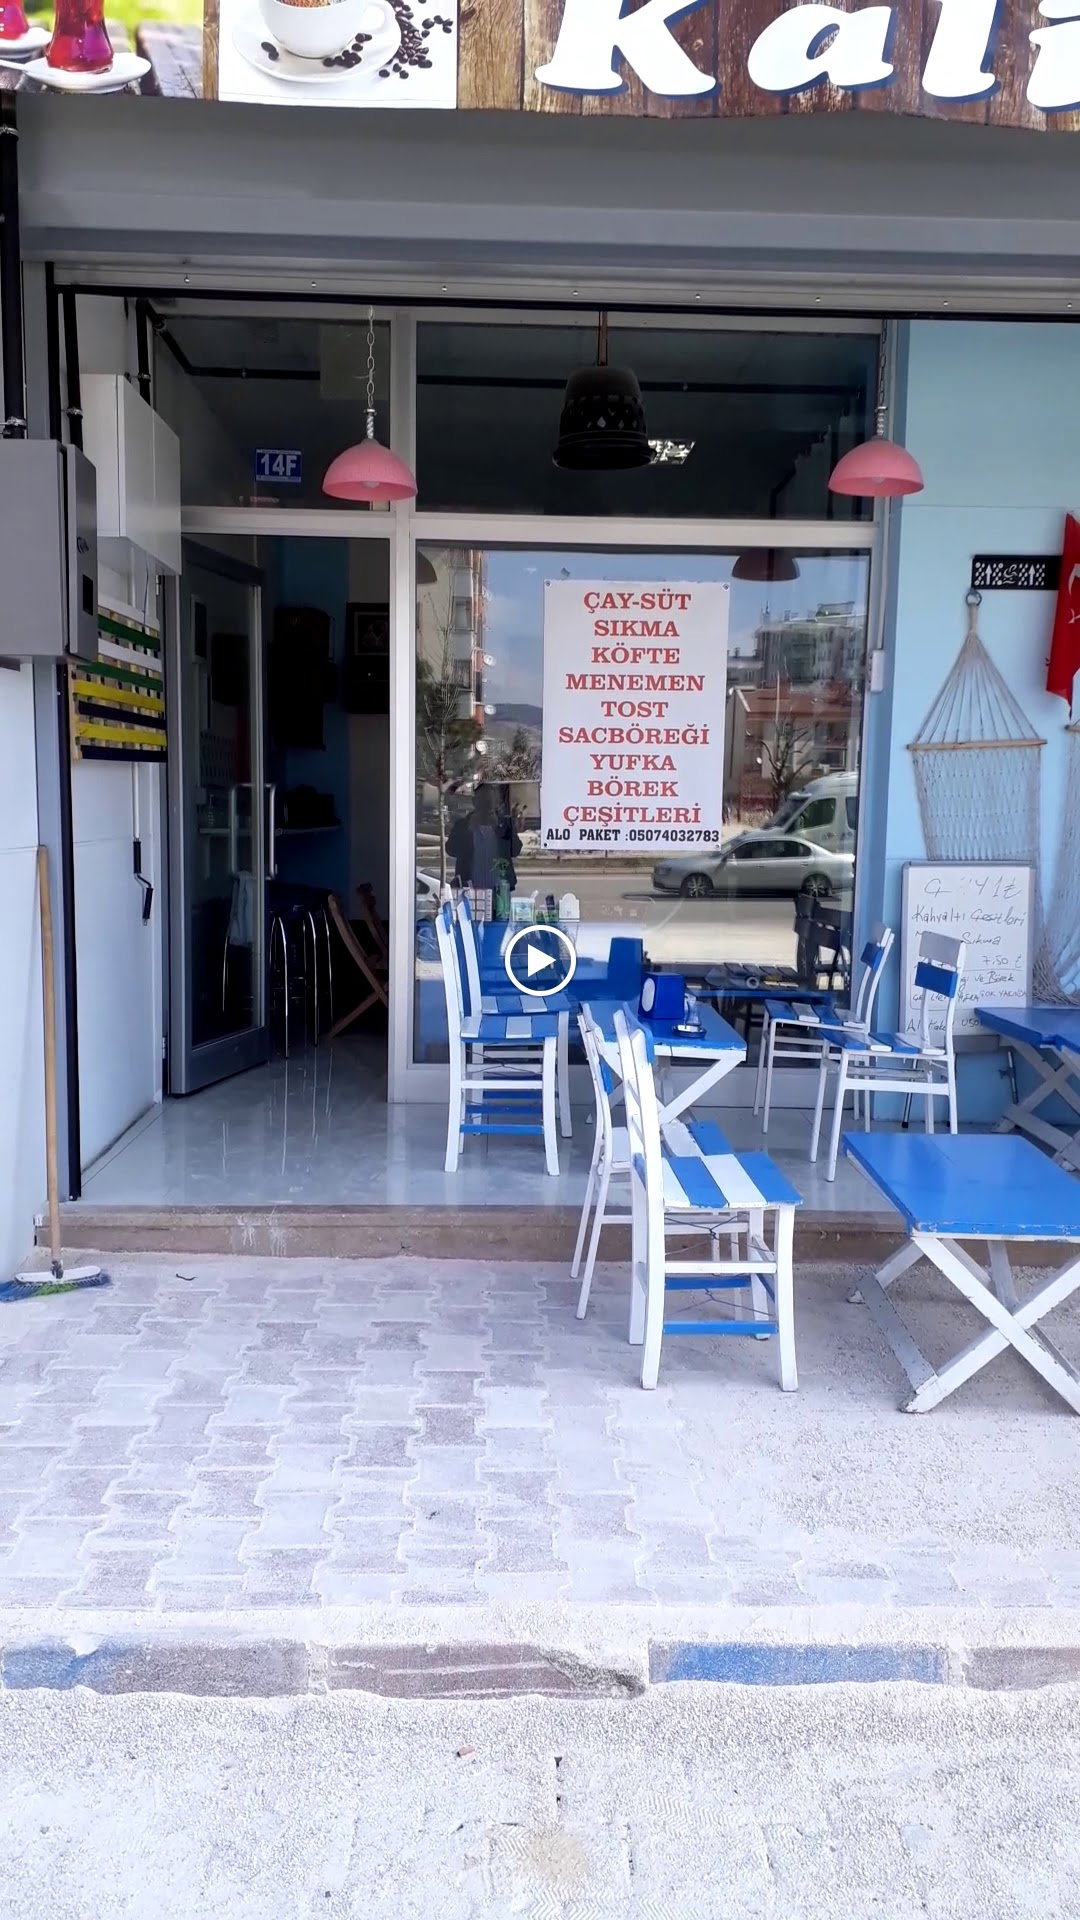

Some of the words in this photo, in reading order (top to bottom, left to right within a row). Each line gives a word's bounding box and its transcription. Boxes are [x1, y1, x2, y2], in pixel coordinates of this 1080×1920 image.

[261, 454, 297, 476] 14F
[583, 589, 691, 613] ÇAY-SÜT
[594, 620, 680, 637] SIKMA
[591, 642, 680, 665] KÖFTE
[565, 674, 705, 691] MENEMEN
[601, 701, 669, 718] TOST
[558, 723, 710, 745] SACBÖREĞİ
[590, 754, 676, 771] YUFKA
[587, 776, 679, 797] BÖREK
[563, 803, 701, 826] ÇEŞİTLERİ
[546, 828, 571, 841] ALO
[579, 829, 621, 842] PAKET
